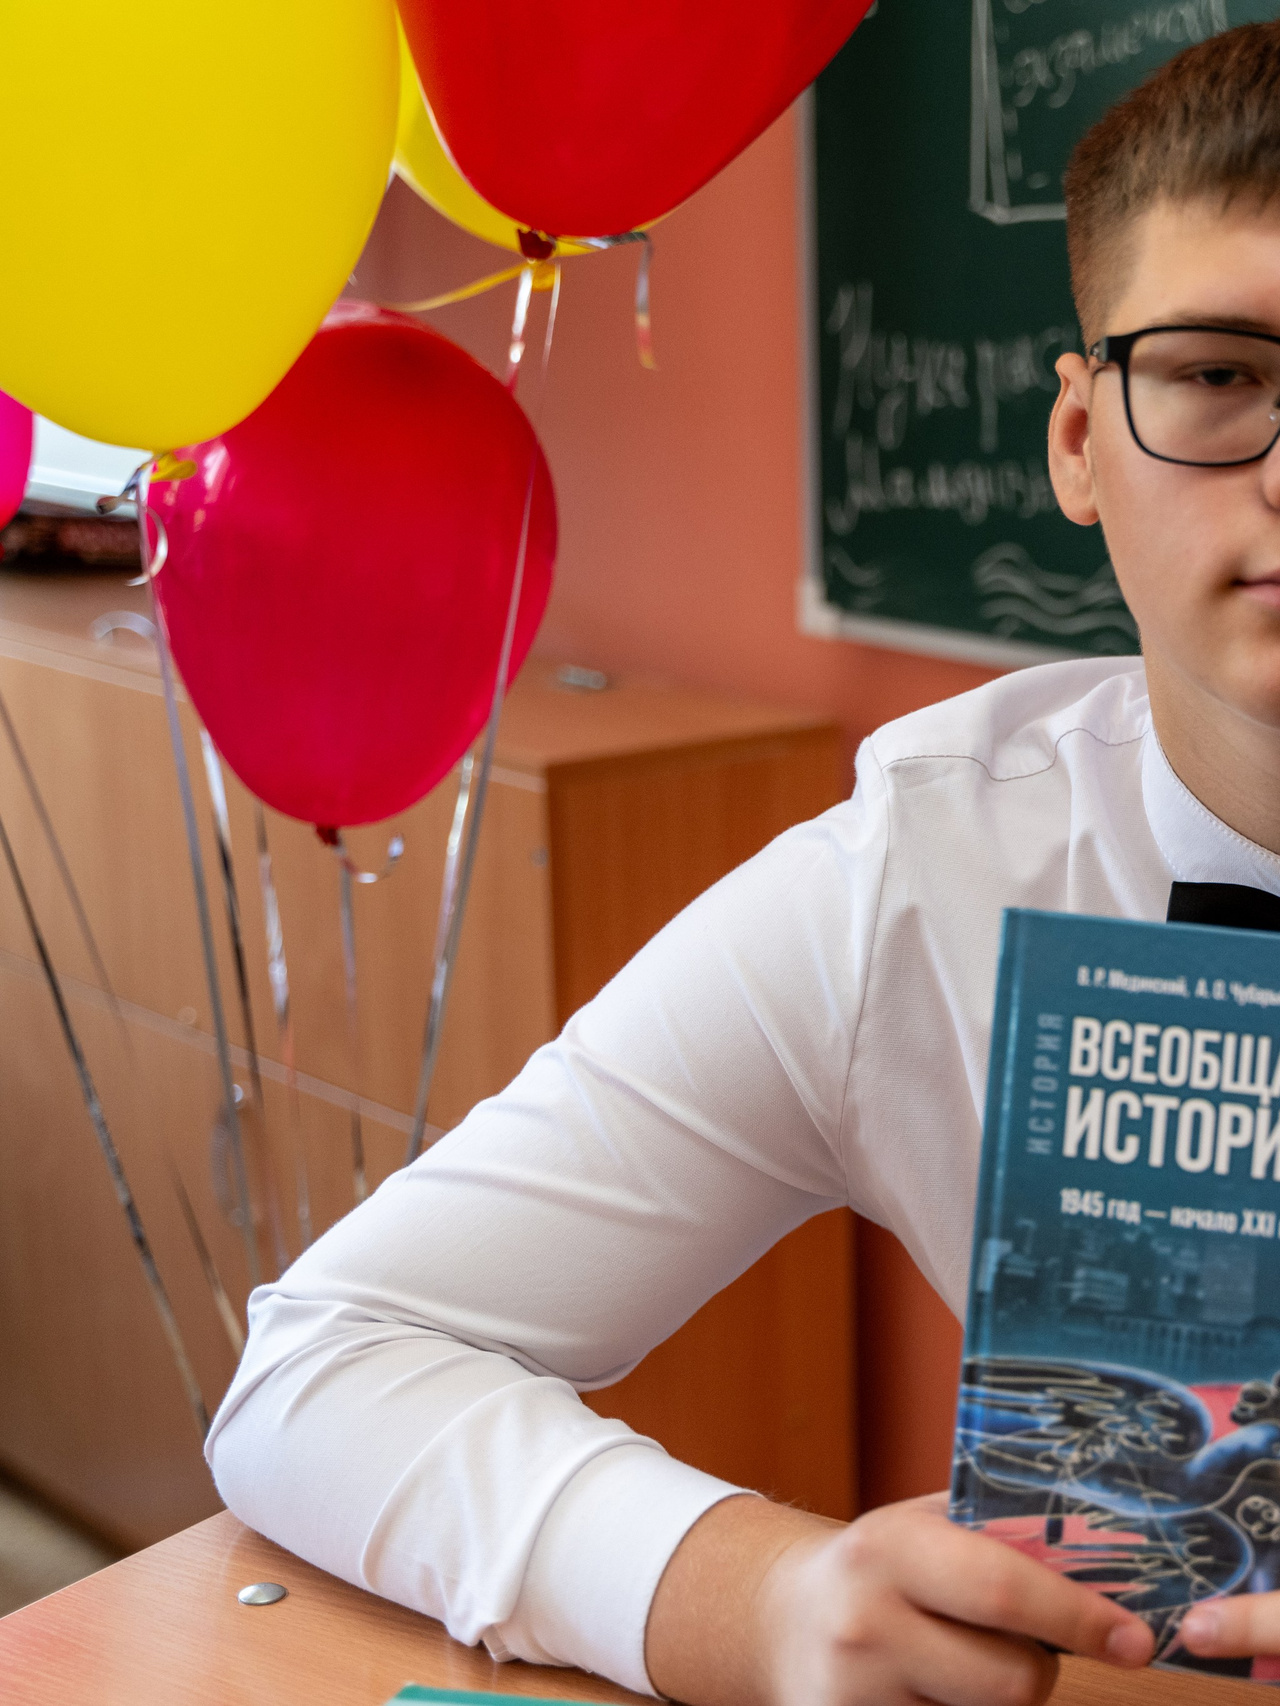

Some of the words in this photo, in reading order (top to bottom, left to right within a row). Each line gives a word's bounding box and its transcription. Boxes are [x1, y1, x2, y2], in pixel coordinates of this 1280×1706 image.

[1025, 1013, 1064, 1155] ИСТОРИЯ
[1060, 1188, 1104, 1218] 1945
[1106, 1199, 1142, 1225] год
[1169, 1206, 1238, 1233] начало
